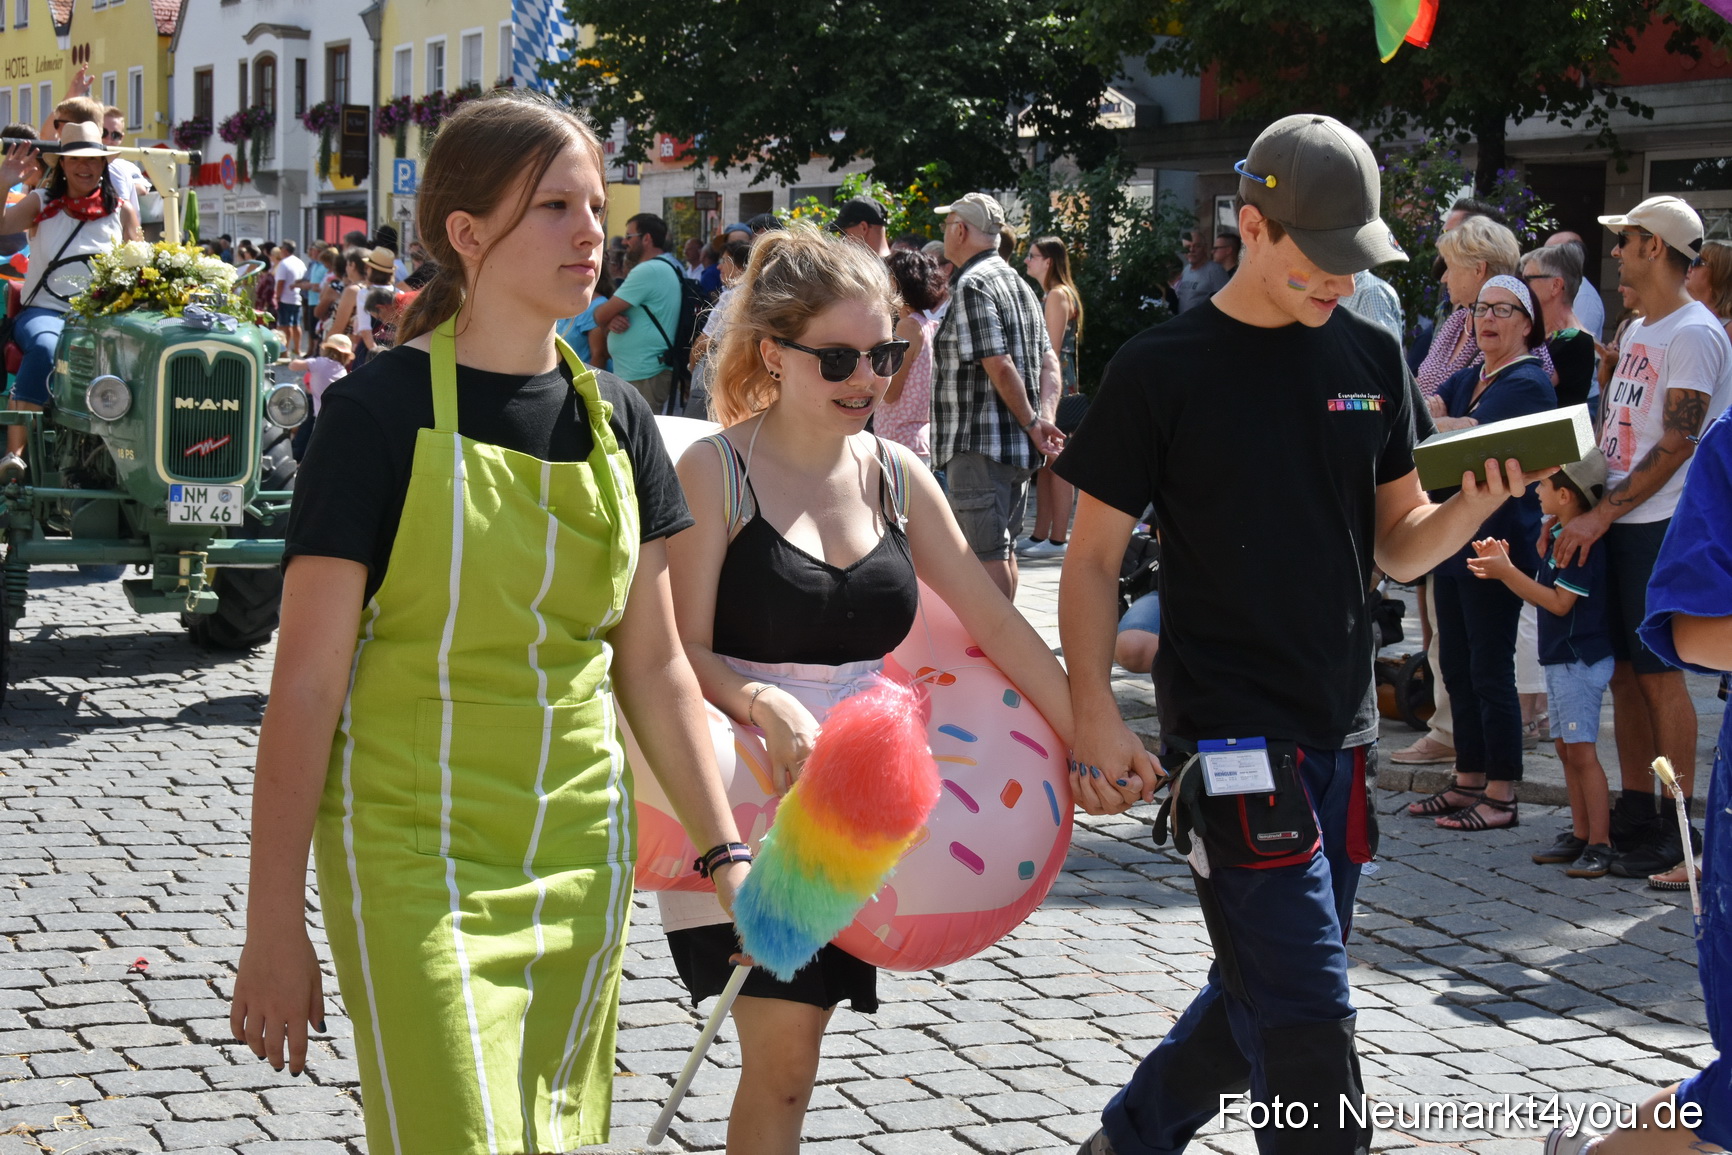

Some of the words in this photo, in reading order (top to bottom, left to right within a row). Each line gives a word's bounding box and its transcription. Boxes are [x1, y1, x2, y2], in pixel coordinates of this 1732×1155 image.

[5, 56, 30, 80] HOTEL
[398, 163, 412, 191] P
[117, 447, 125, 460] 18
[125, 448, 135, 460] PS
[184, 487, 208, 504] NM
[180, 505, 202, 522] JK
[210, 506, 232, 522] 46
